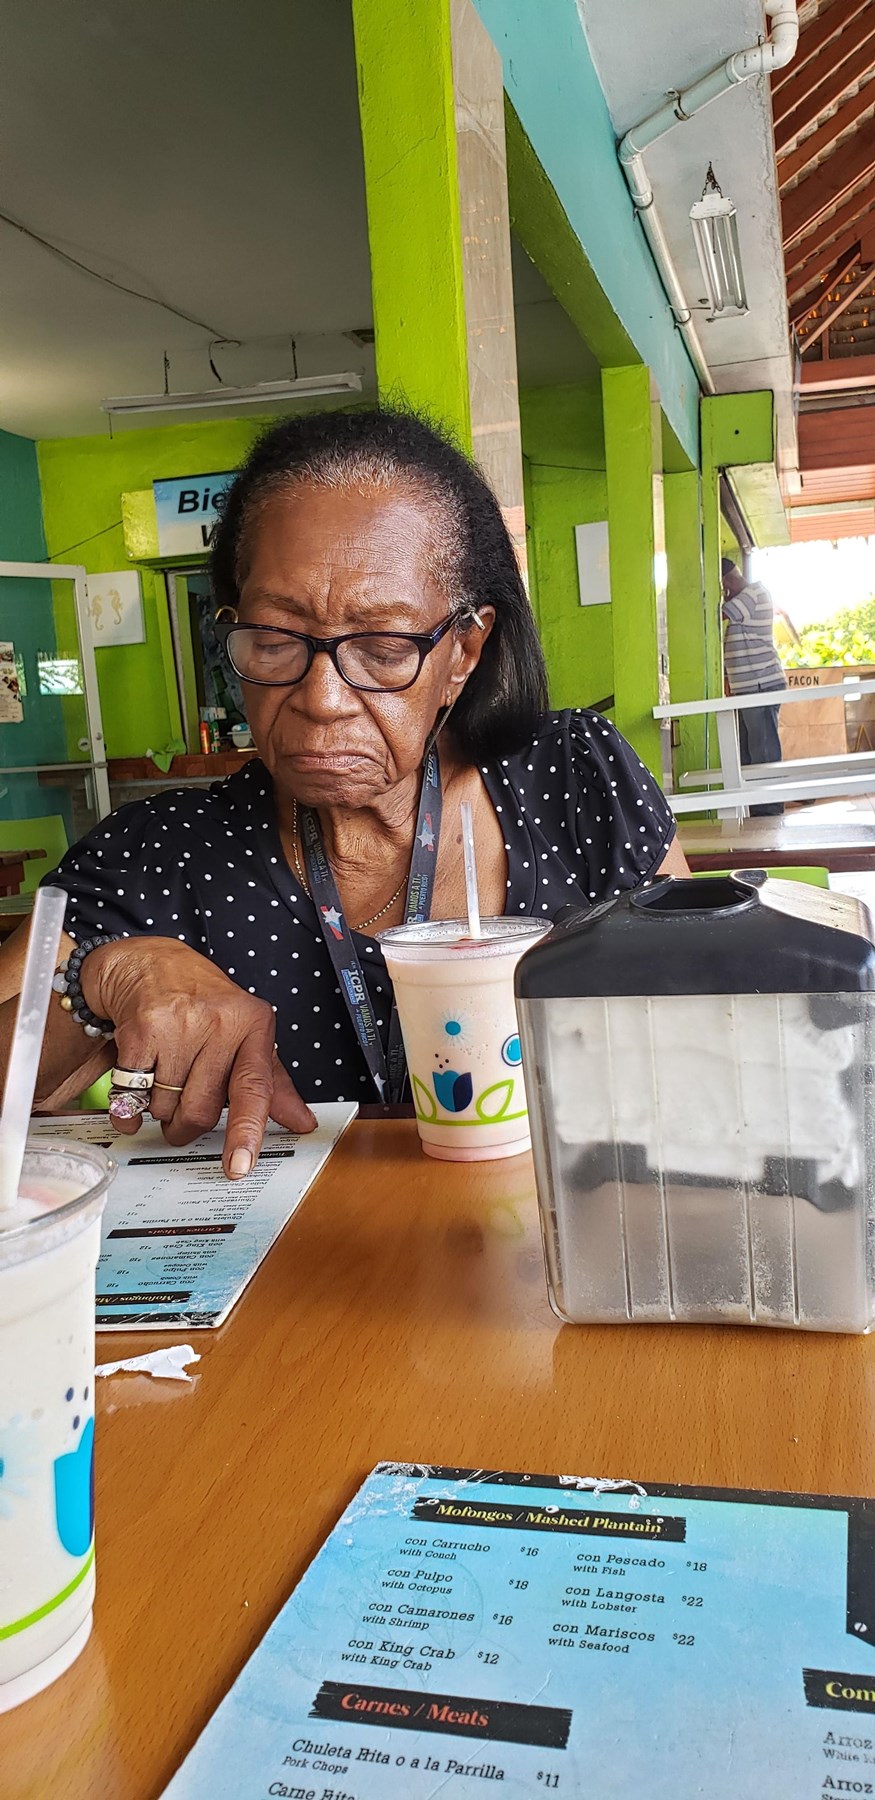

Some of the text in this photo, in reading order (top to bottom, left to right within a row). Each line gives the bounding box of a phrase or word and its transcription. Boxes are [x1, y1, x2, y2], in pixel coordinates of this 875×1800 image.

[788, 676, 819, 686] FACON
[408, 890, 420, 913] VAMOS
[349, 969, 366, 1004] ICPR
[360, 1003, 372, 1028] VAMOS
[436, 1504, 513, 1522] Mofongos
[526, 1512, 589, 1528] Mashed
[592, 1517, 661, 1534] Plantain
[399, 1548, 457, 1560] with Conch
[405, 1536, 539, 1557] con Carrucho $16
[573, 1564, 626, 1576] with Fish
[577, 1553, 708, 1572] con Pescado $18
[381, 1580, 453, 1595] with Octopus
[387, 1568, 529, 1590] con Pulpo $18
[561, 1598, 638, 1613] with Lobster
[565, 1586, 704, 1607] con Langosta $22
[362, 1614, 430, 1630] with Shrimp
[368, 1602, 513, 1626] con Camarones $16
[552, 1623, 695, 1646] con Mariscos $22
[348, 1639, 500, 1665] con King Crab $12
[548, 1637, 630, 1654] with Seafood
[341, 1652, 432, 1671] with King Crab
[341, 1692, 489, 1727] Carnes / Meats
[823, 1731, 873, 1750] Arroz
[282, 1756, 349, 1775] Pork Chops
[292, 1739, 352, 1759] Chuleta
[395, 1756, 405, 1766] o
[410, 1758, 419, 1769] a
[424, 1757, 440, 1771] la
[444, 1759, 504, 1781] Parrilla
[536, 1771, 560, 1788] $11
[268, 1782, 315, 1800] Carne
[822, 1775, 873, 1794] Arroz
